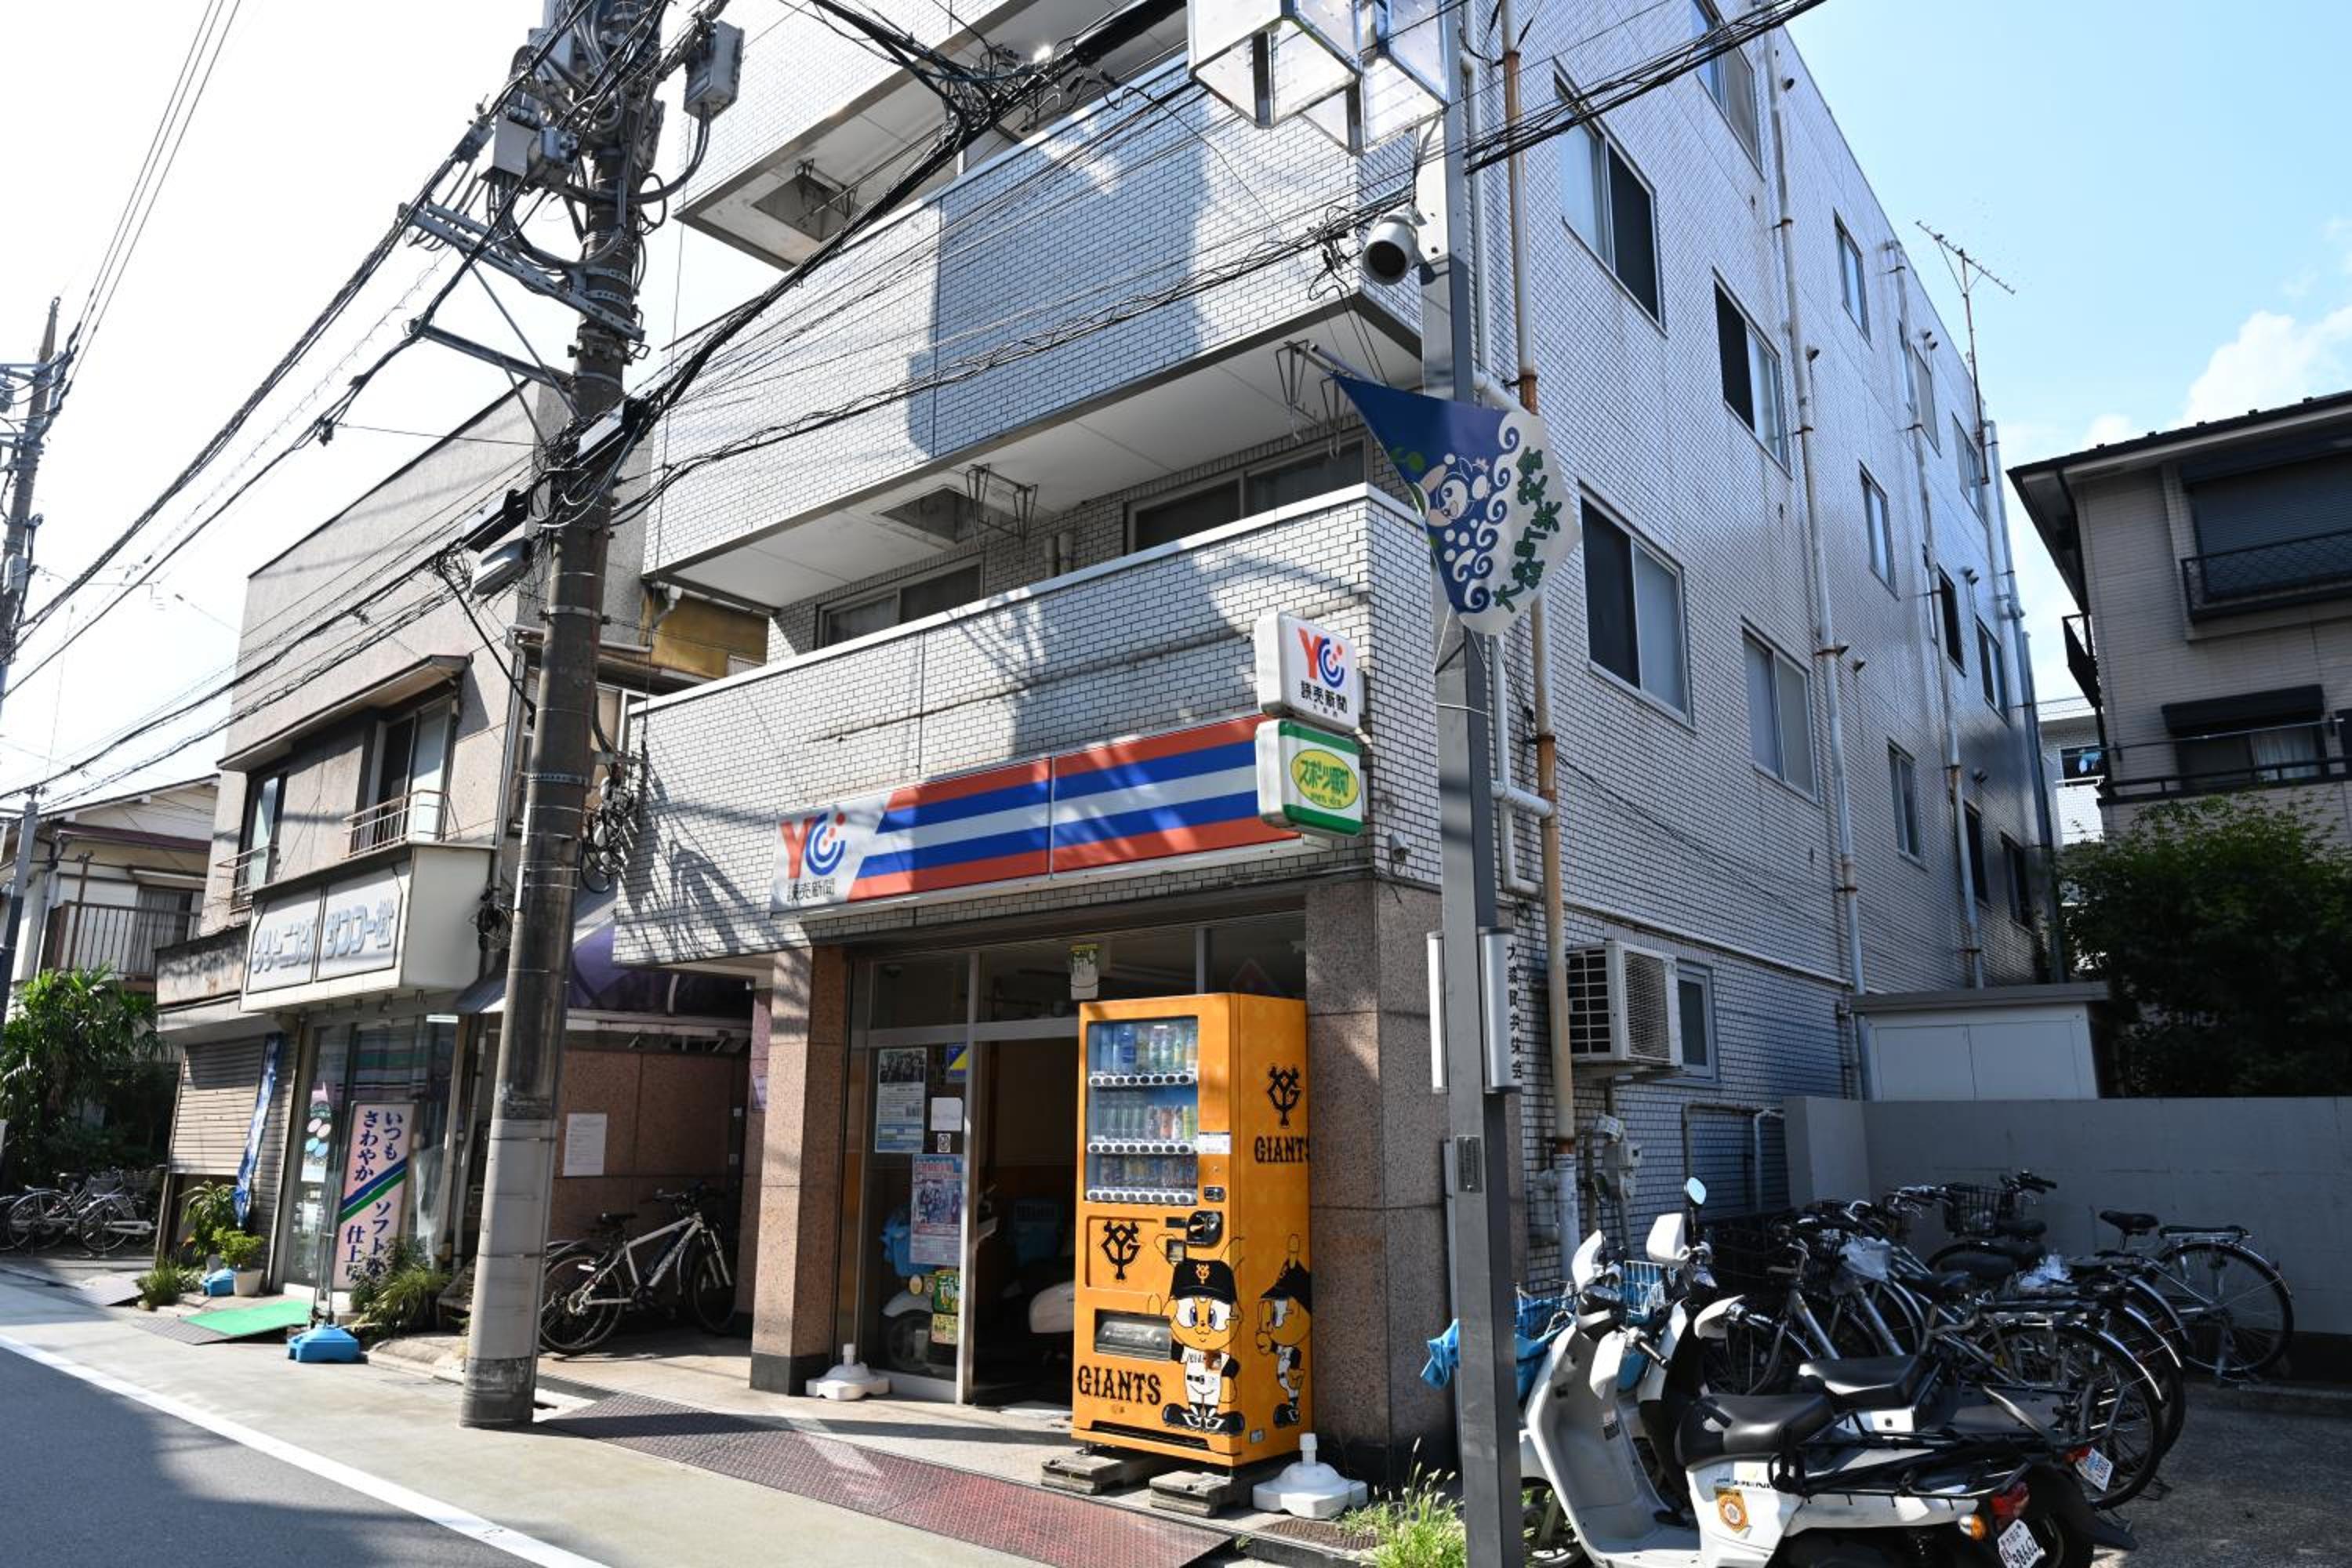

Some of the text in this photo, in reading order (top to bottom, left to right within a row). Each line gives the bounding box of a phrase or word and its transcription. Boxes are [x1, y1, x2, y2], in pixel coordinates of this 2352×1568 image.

[1301, 680, 1348, 713] 読売新聞
[354, 1110, 379, 1181] さわやか
[383, 1112, 403, 1161] いつも
[1077, 1365, 1162, 1406] GIANTS
